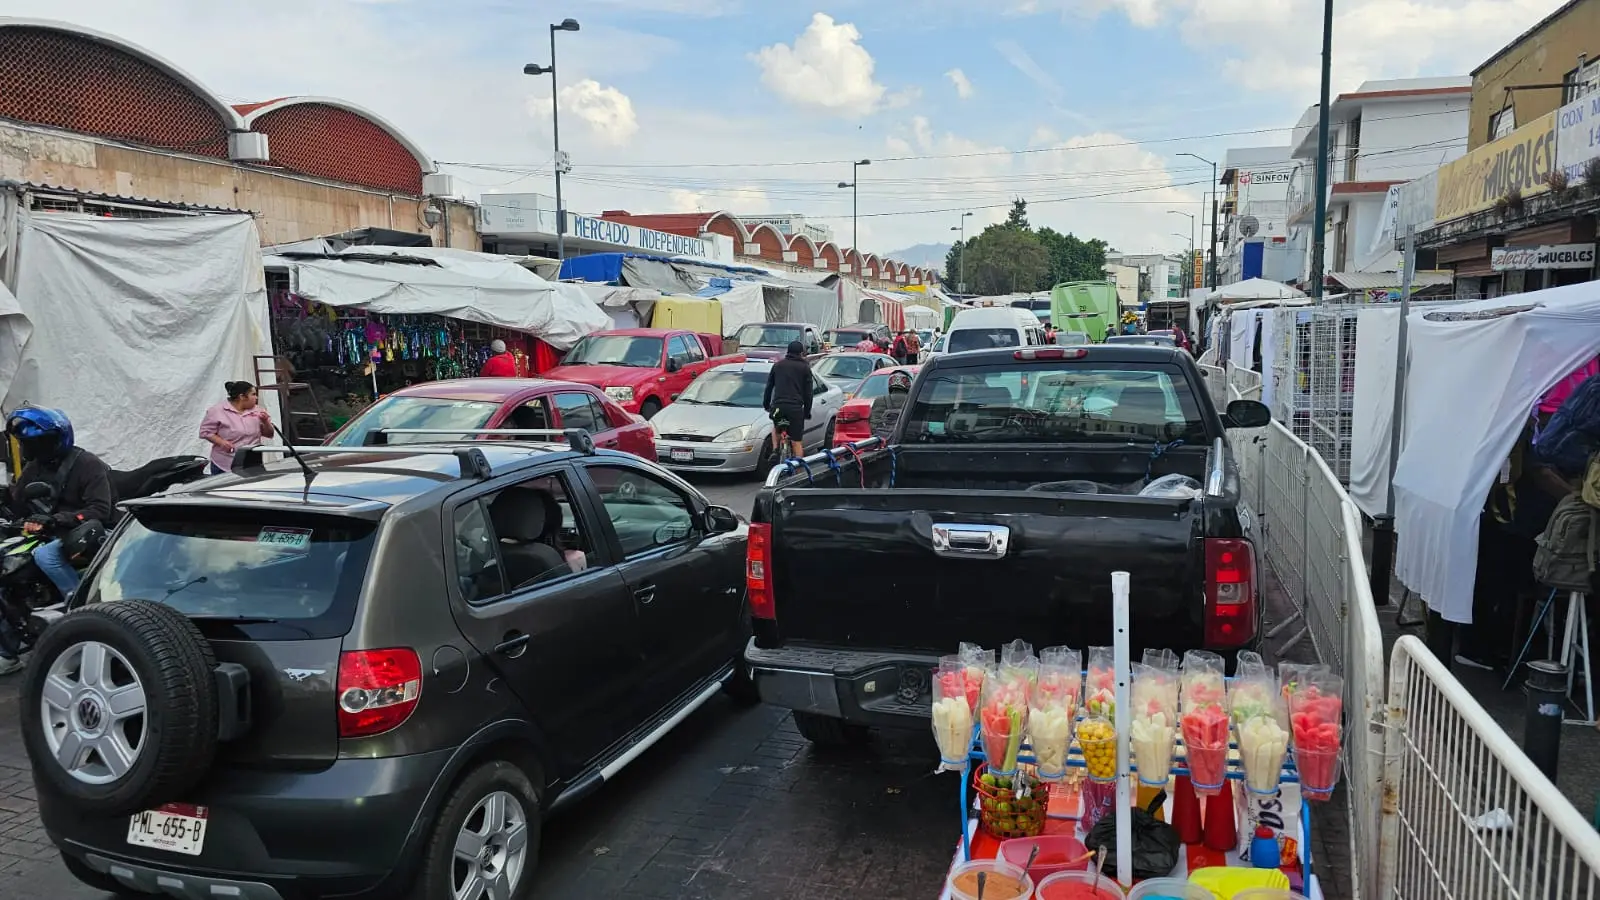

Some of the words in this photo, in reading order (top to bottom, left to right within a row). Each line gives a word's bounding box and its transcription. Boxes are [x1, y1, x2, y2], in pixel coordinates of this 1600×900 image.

[1561, 105, 1584, 129] CON
[1483, 128, 1554, 202] MUEBLES
[574, 215, 630, 245] MERCADO
[639, 227, 706, 257] INDEPENDENCIA
[1537, 250, 1593, 264] MUEBLES
[131, 811, 202, 842] PML-655-B
